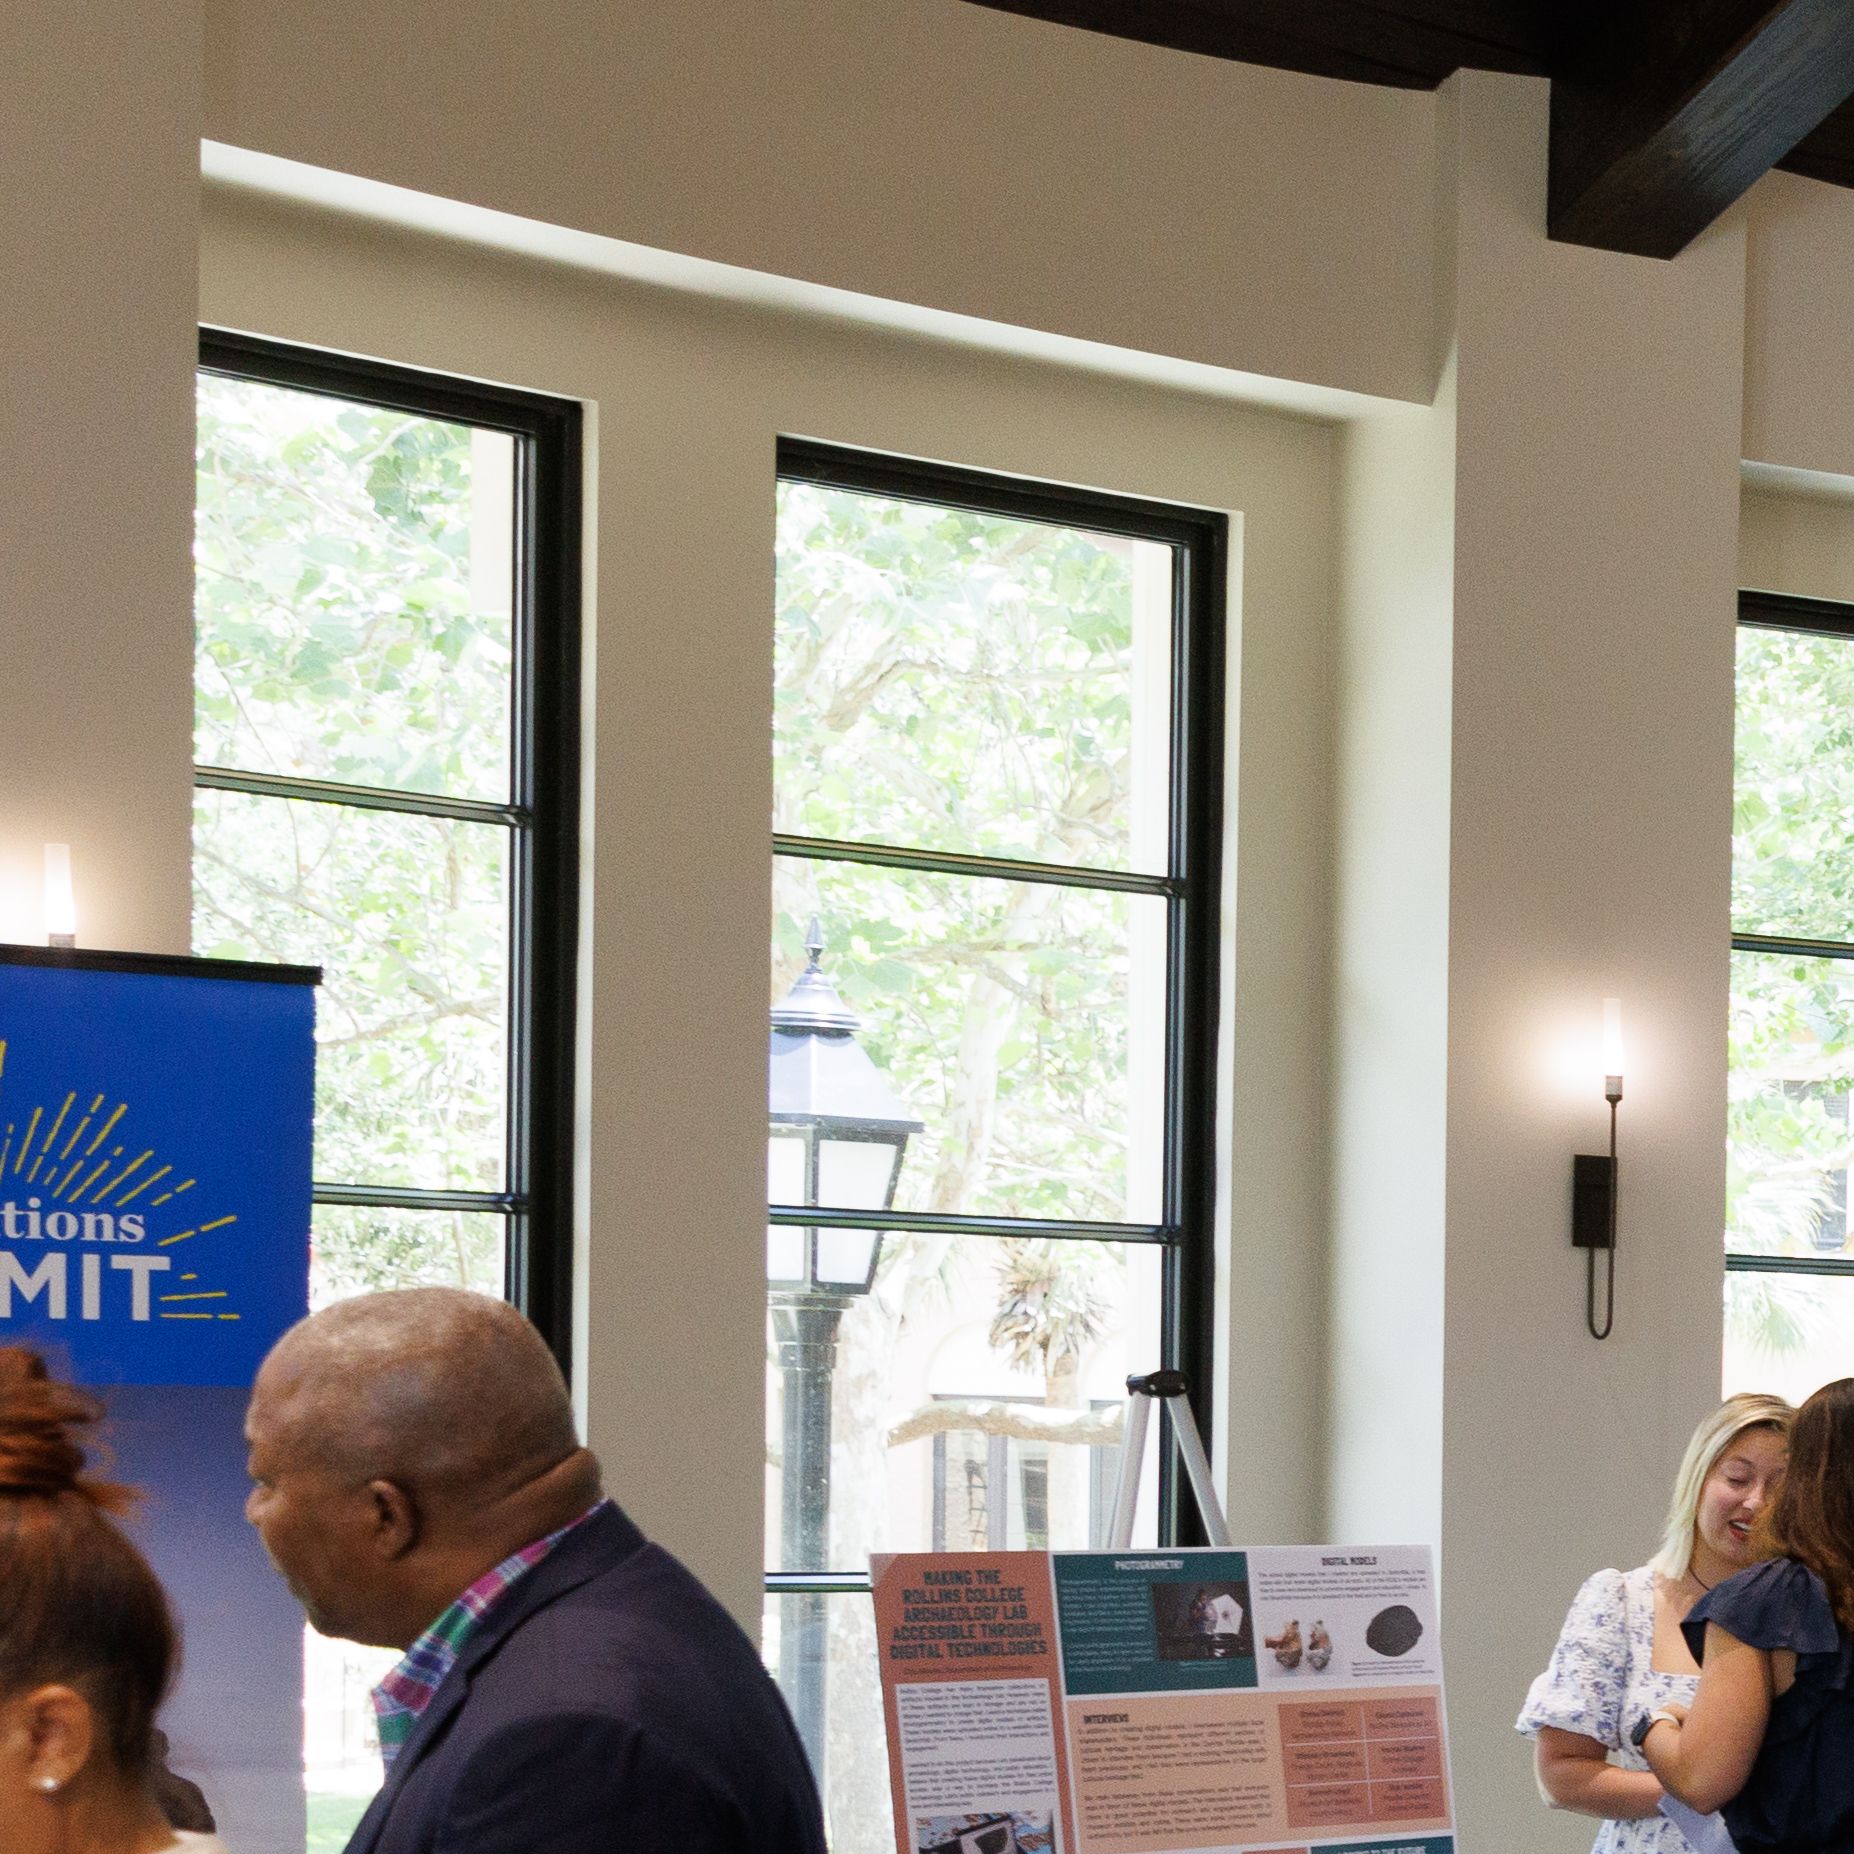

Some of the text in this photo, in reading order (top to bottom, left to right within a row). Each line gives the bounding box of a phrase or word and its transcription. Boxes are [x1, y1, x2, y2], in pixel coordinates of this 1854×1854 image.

[0, 1197, 146, 1243] tions
[0, 1252, 171, 1321] MIT
[923, 1570, 1000, 1585] MAKING THE
[903, 1586, 1024, 1604] ROLLINS COLLEGE
[1003, 1605, 1027, 1619] LAB
[893, 1623, 1041, 1640] ACCESSIBLE THROUGH
[890, 1640, 1047, 1659] DIGITAL TECHNOLOGIES
